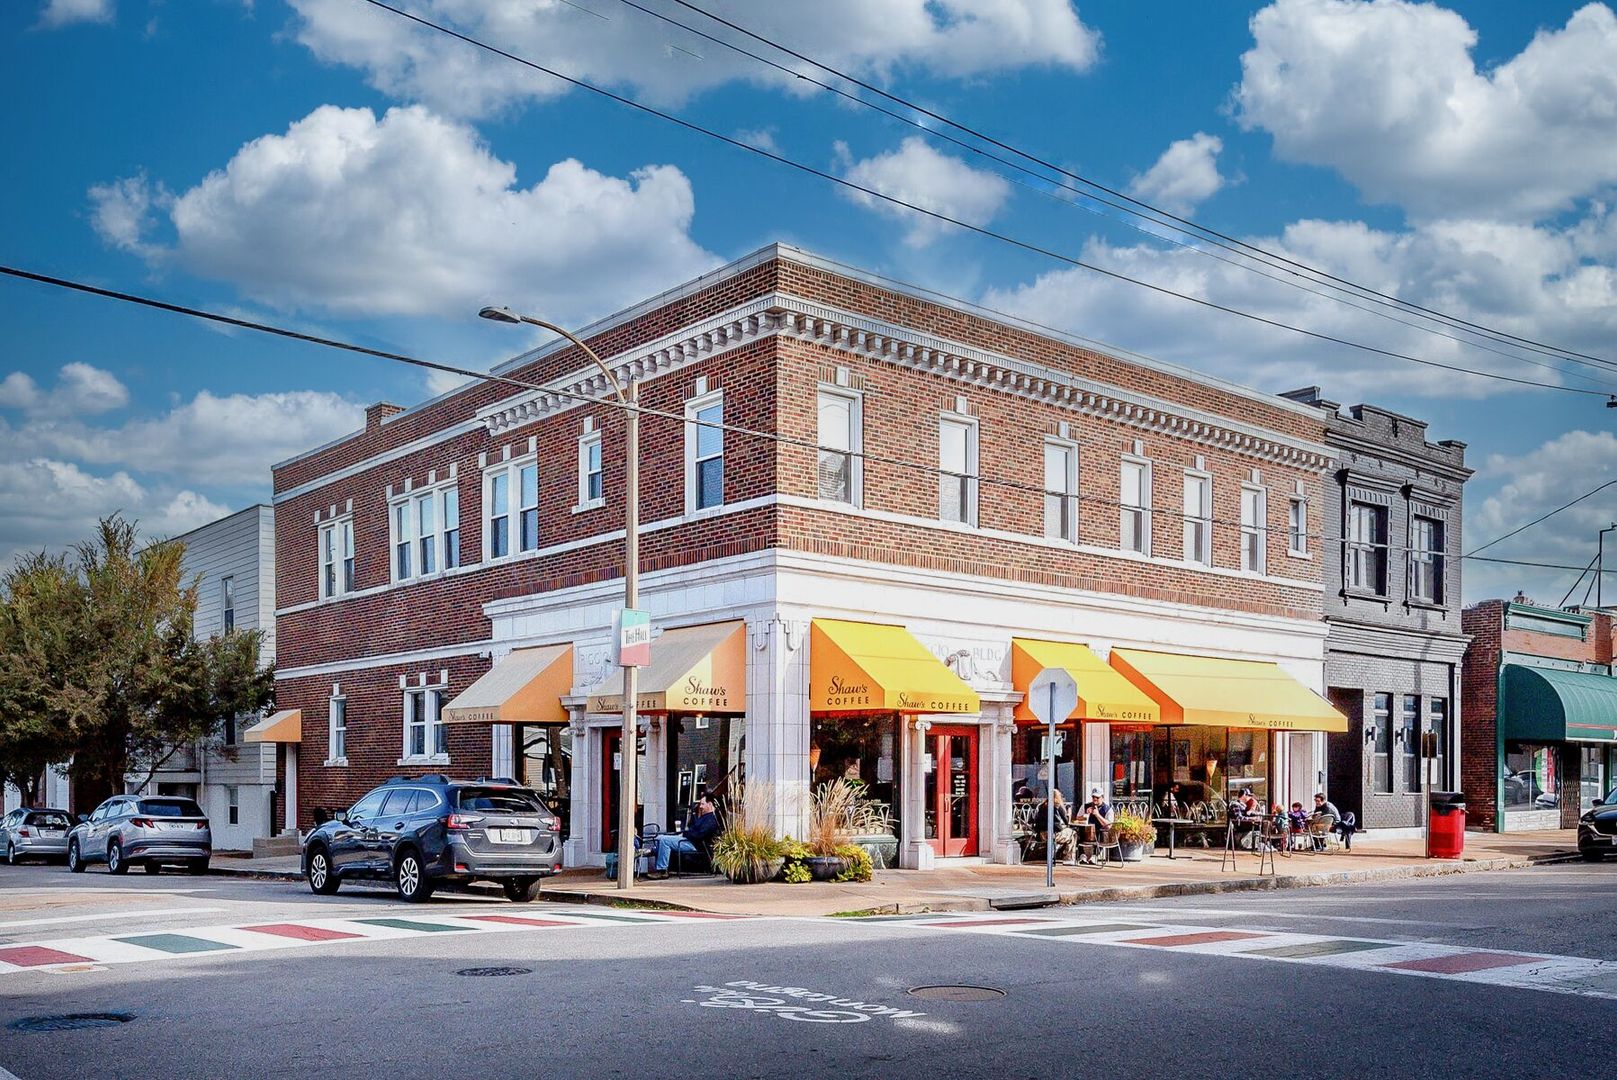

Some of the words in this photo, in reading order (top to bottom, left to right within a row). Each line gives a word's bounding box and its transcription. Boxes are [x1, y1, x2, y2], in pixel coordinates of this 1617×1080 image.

[684, 675, 727, 696] Shaw's
[827, 675, 868, 695] Shaw's
[636, 700, 656, 709] FFEE
[683, 697, 728, 707] COFFEE
[826, 696, 869, 706] COFFEE
[896, 692, 925, 708] Shaw's
[930, 701, 968, 711] COFFEE
[468, 712, 494, 721] COFFEE
[1121, 711, 1152, 720] COFFEE
[1268, 720, 1294, 728] COFFEE
